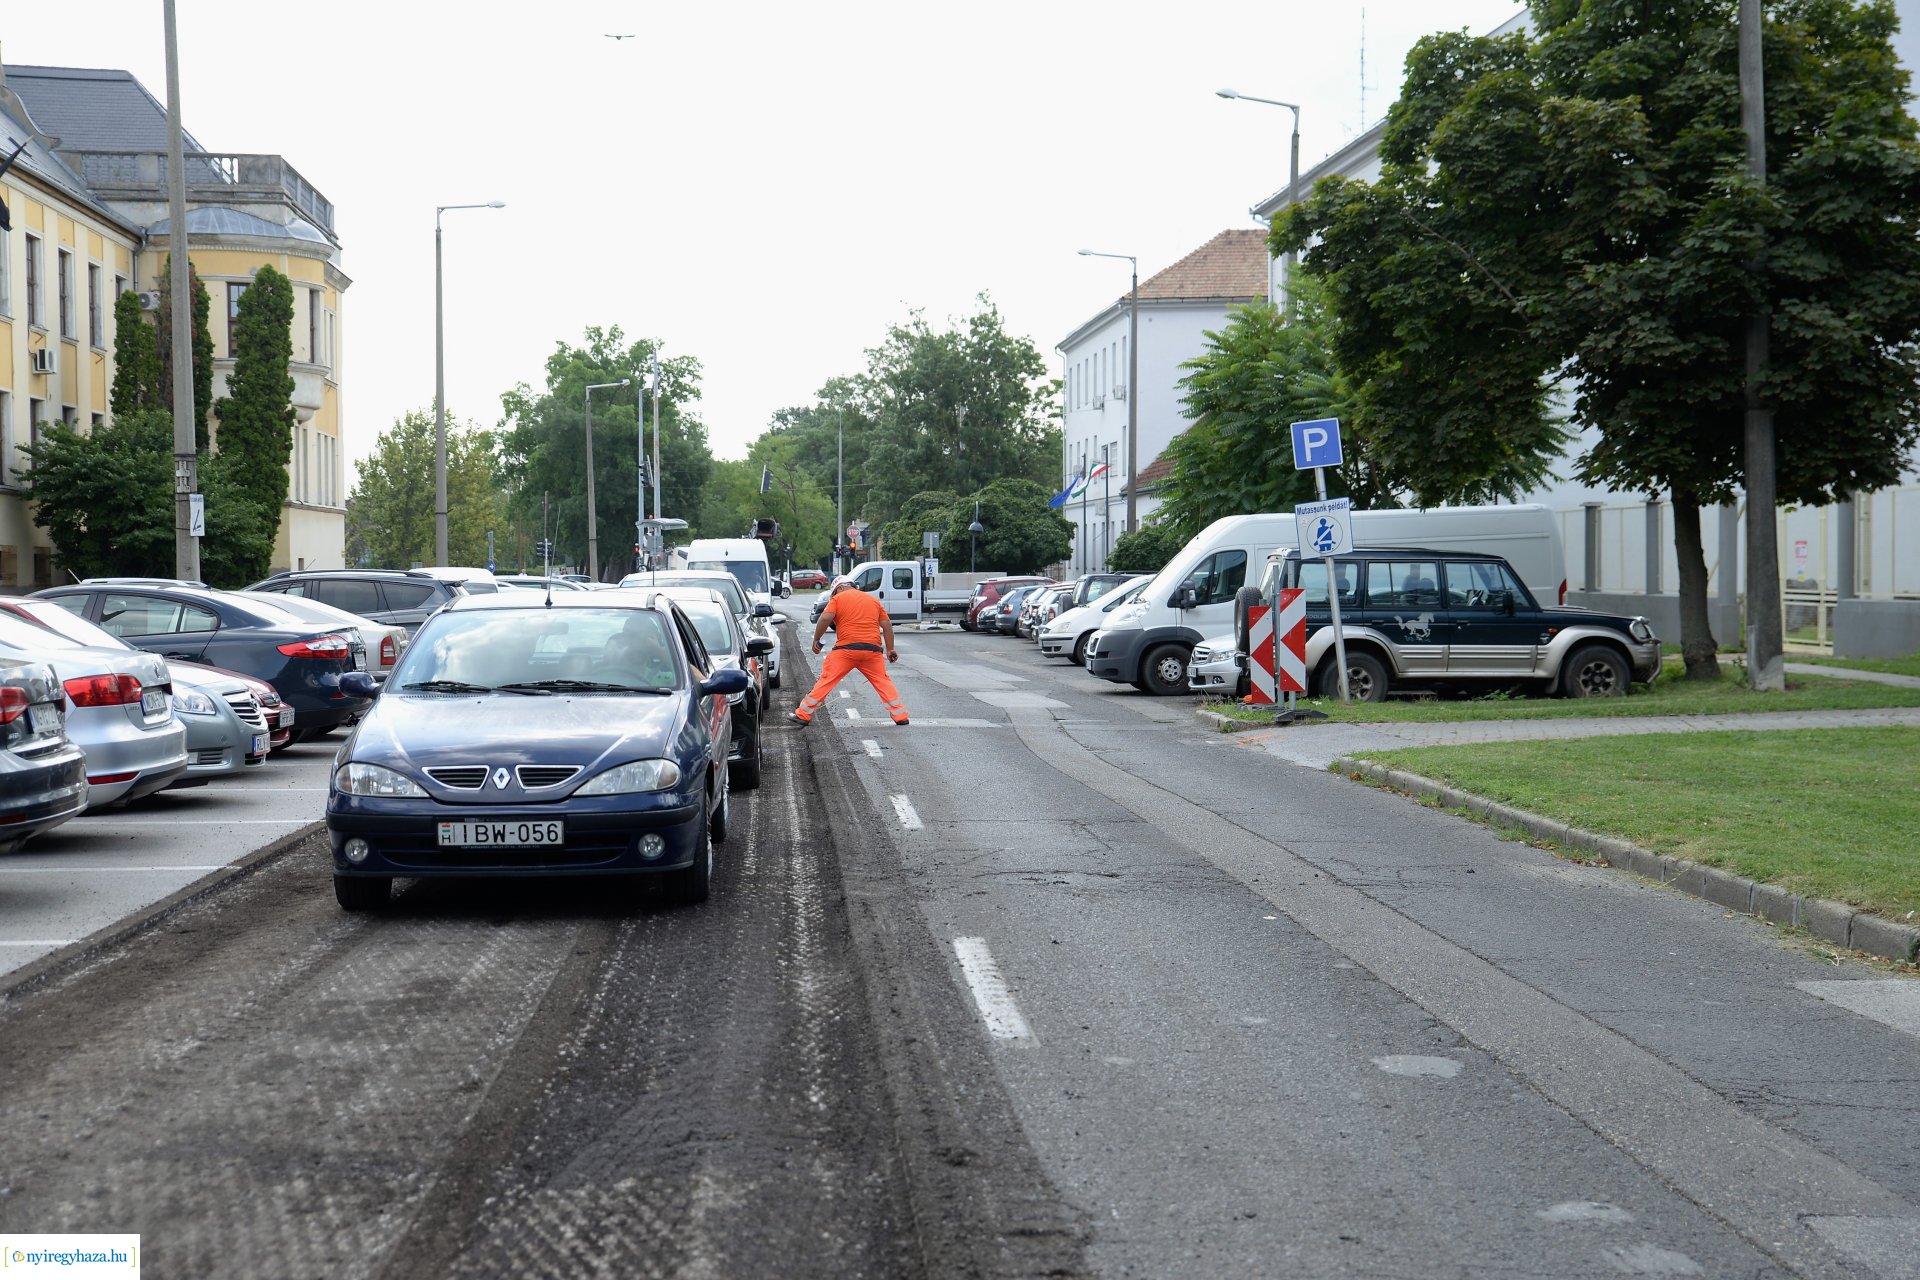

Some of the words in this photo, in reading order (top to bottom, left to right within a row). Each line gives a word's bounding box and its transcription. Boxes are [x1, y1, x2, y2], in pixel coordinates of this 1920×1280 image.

[1303, 427, 1328, 462] P
[1297, 504, 1327, 516] Mutassunk
[463, 823, 559, 843] IBW-056
